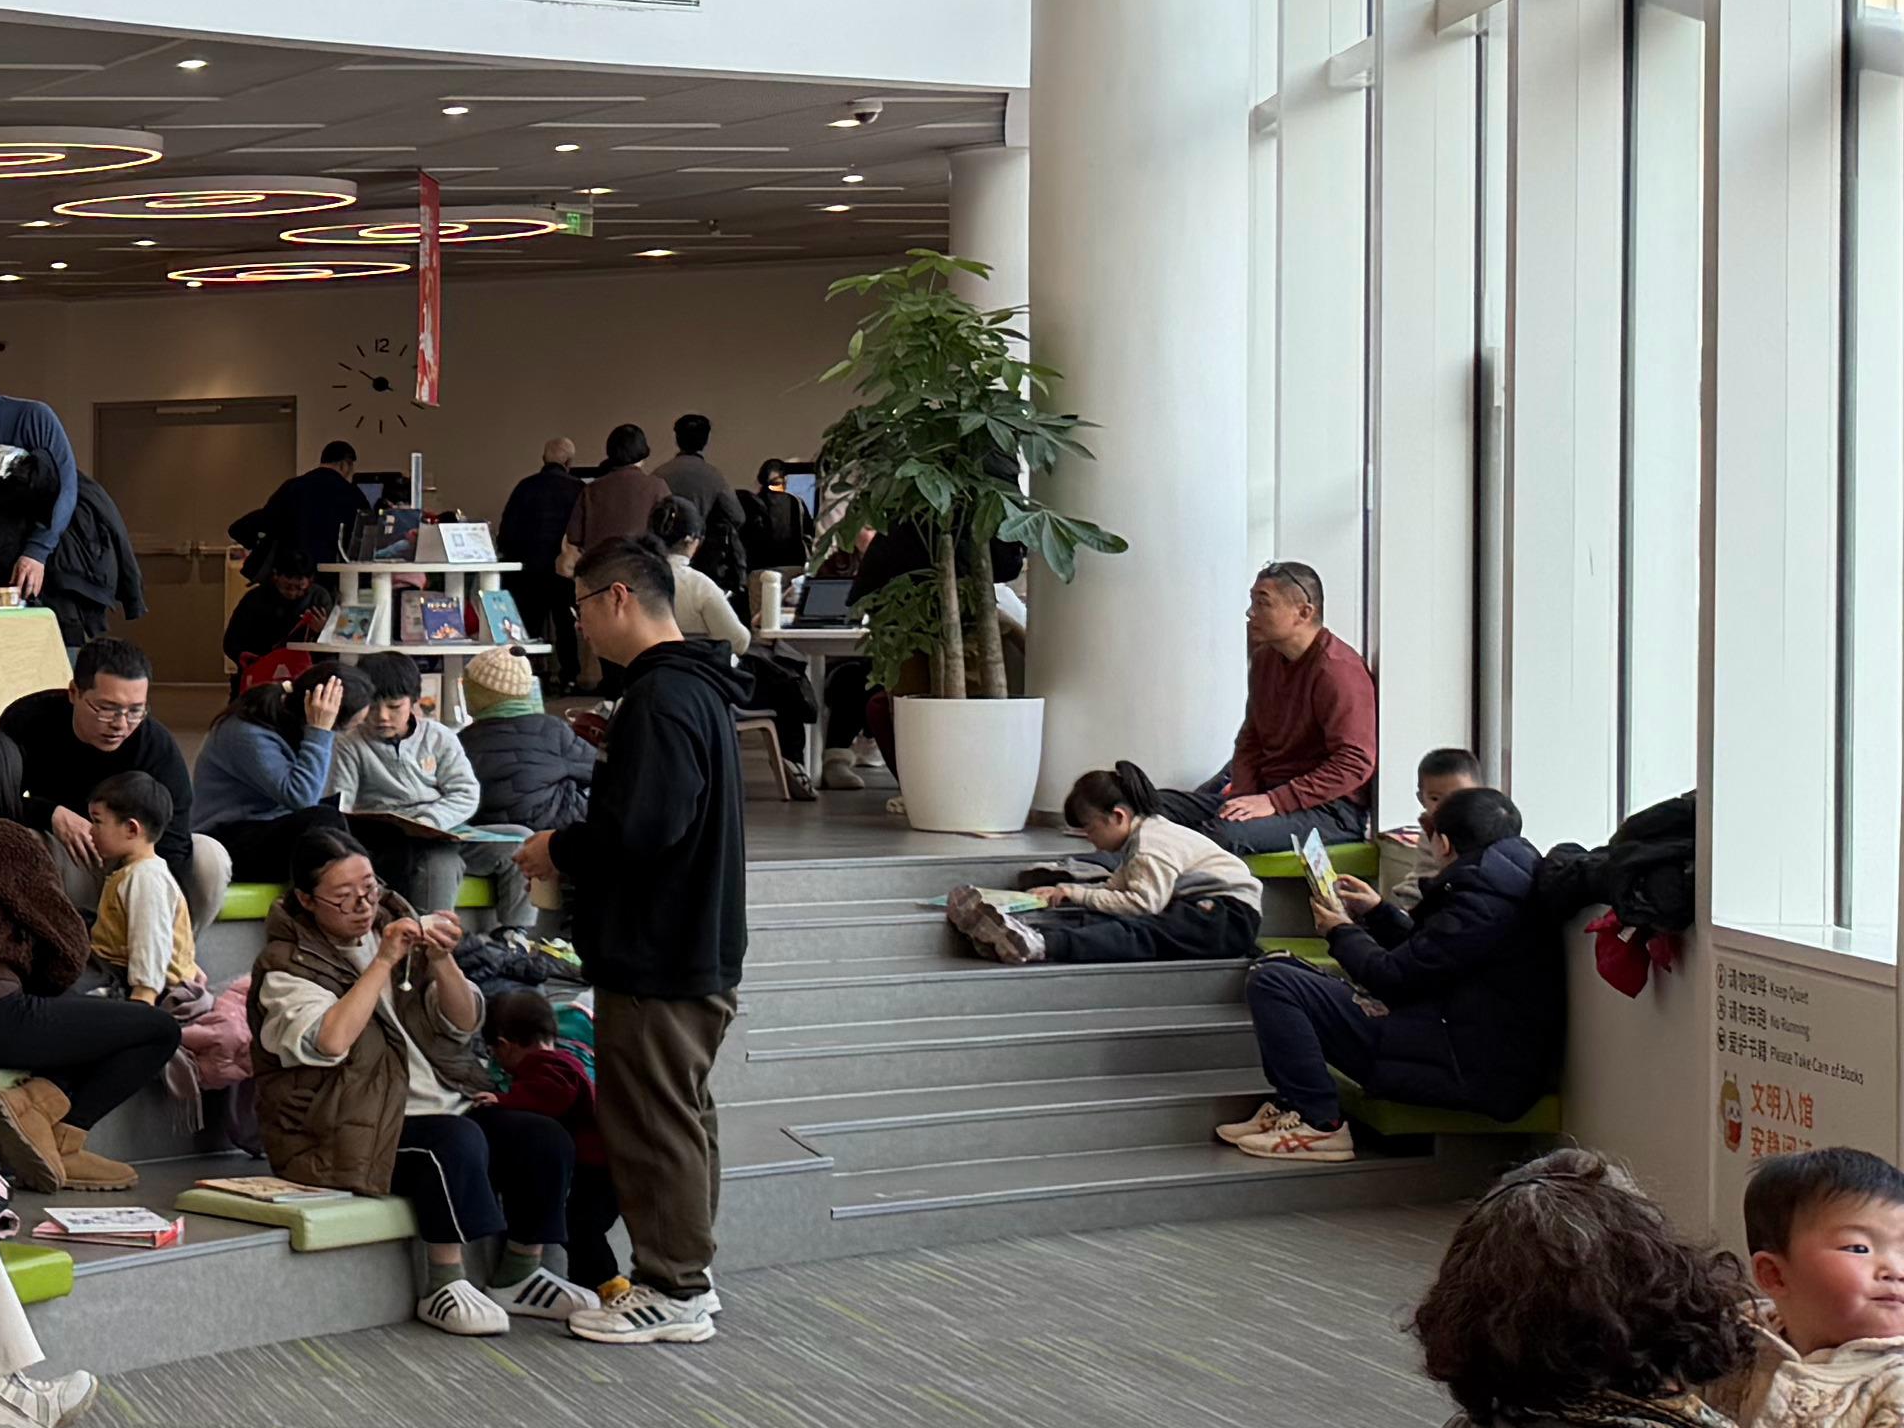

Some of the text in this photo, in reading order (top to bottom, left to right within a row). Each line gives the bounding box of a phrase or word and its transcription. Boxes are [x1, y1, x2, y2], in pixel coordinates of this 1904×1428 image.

[375, 338, 389, 353] 12
[1770, 983, 1788, 1002] Keep
[1770, 1046, 1793, 1066] Please
[1793, 1052, 1812, 1071] Take
[1813, 1057, 1829, 1075] Care
[1831, 1063, 1840, 1078] of
[1840, 1065, 1864, 1085] Books
[1751, 1079, 1814, 1129] 文明入馆
[1751, 1125, 1813, 1157] 安静阅
